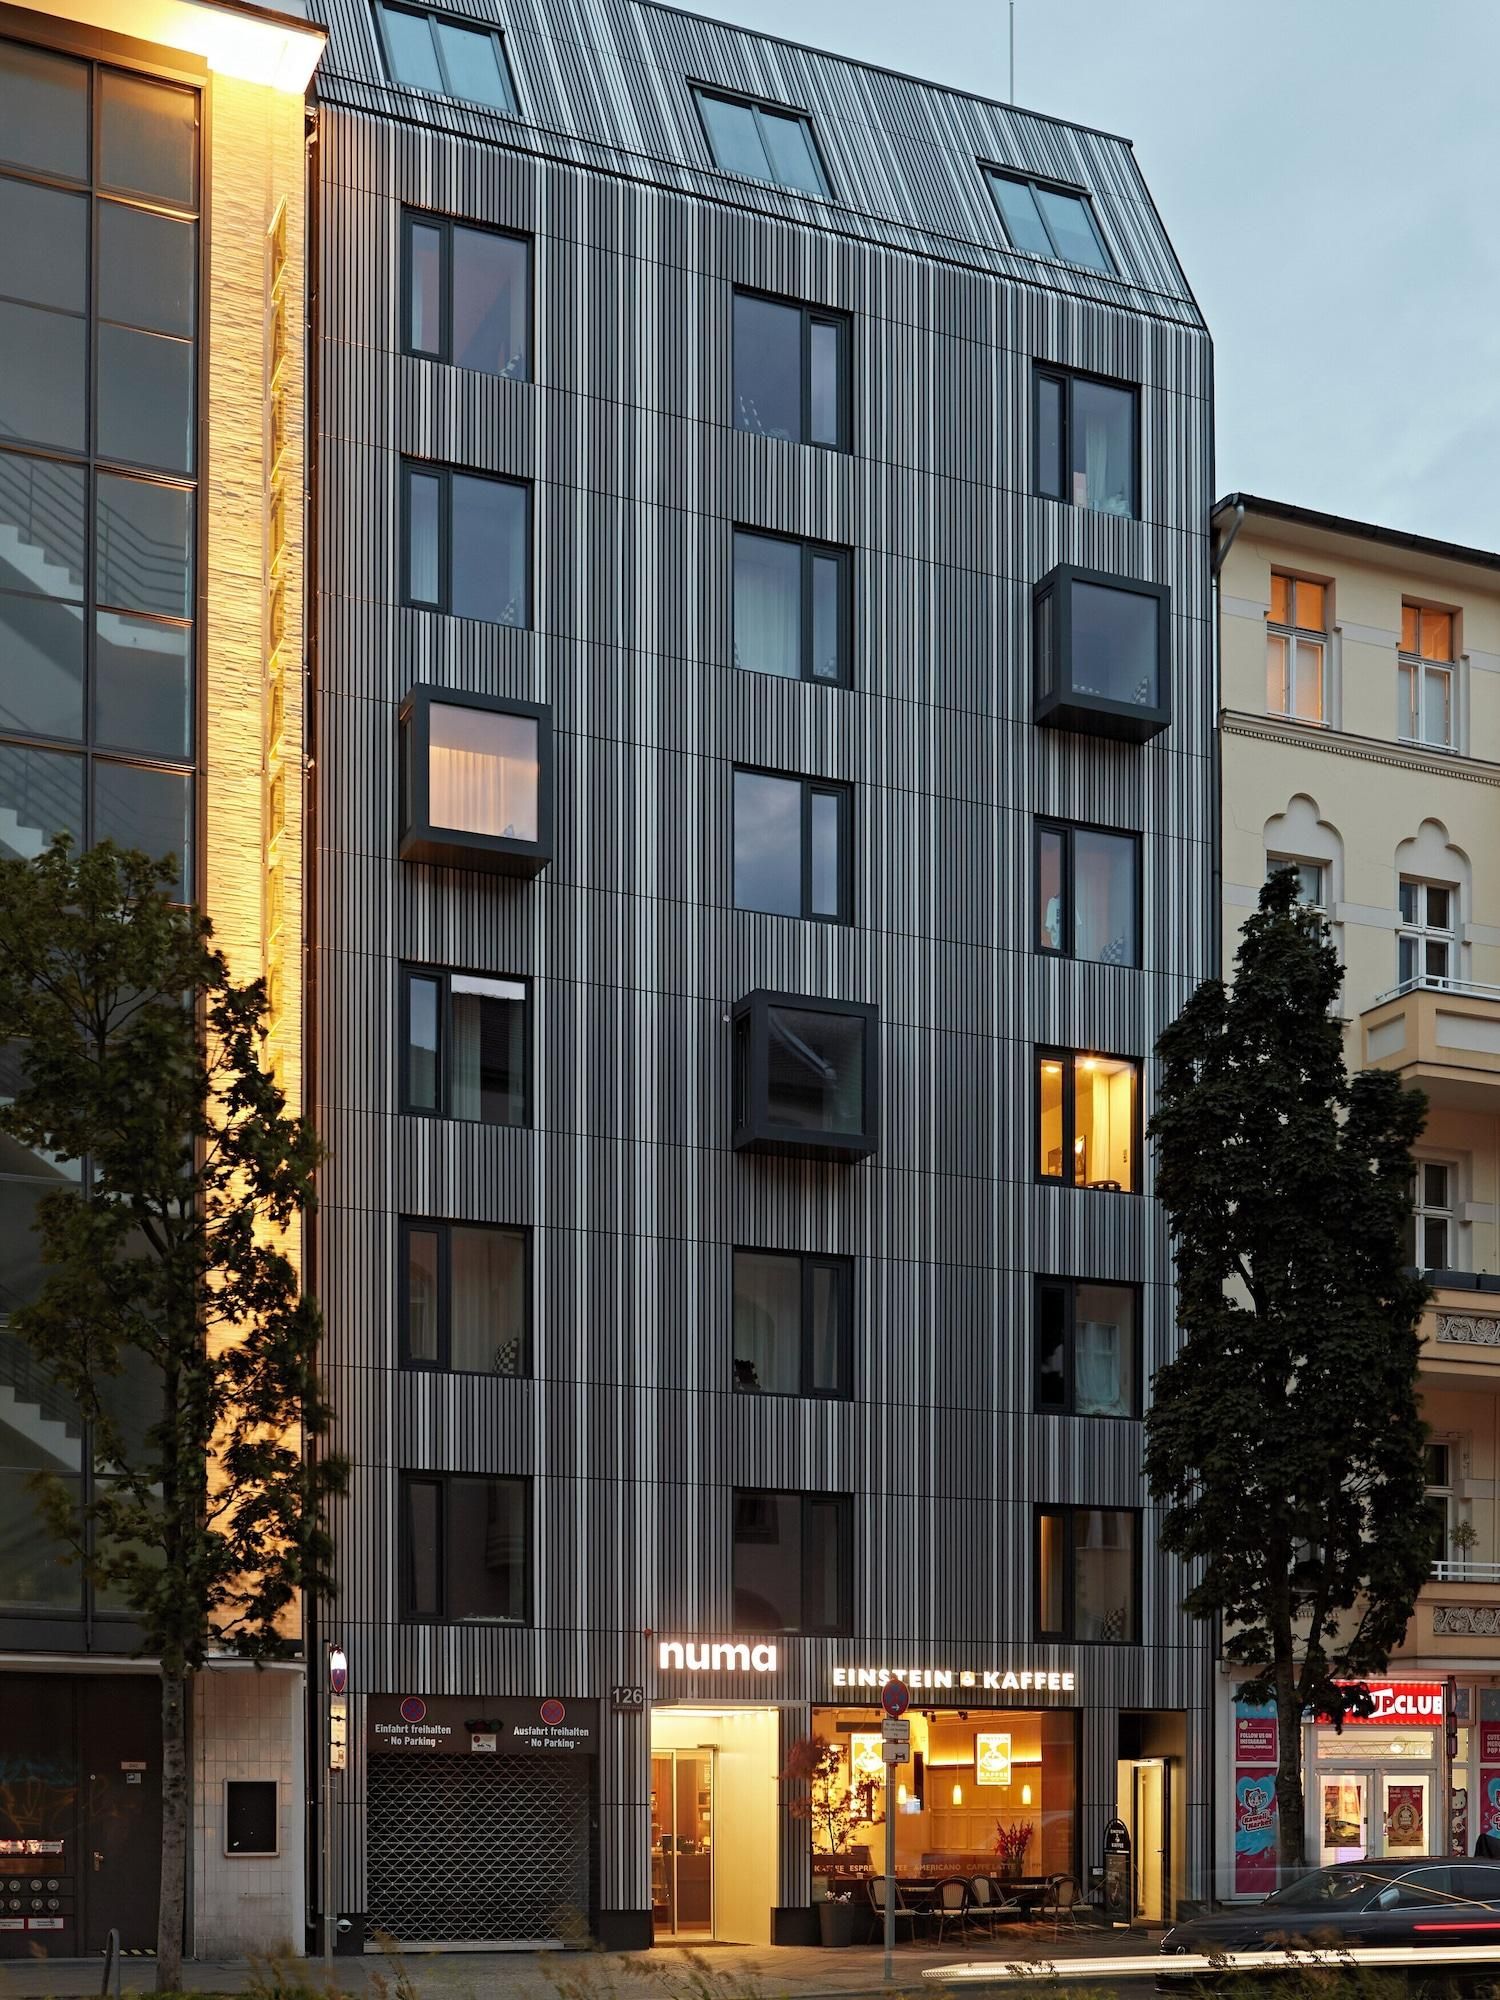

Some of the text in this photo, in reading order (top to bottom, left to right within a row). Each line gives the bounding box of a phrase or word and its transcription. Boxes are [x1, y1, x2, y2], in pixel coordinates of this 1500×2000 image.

[659, 1642, 777, 1672] numa
[833, 1668, 1075, 1691] EINSTEIN KAFFEE
[612, 1688, 643, 1704] 126
[375, 1724, 452, 1734] Einfahrt freihalten
[513, 1726, 589, 1736] Ausfahrt freihalten
[390, 1736, 402, 1745] No
[404, 1736, 436, 1747] Parking
[531, 1738, 542, 1747] No
[544, 1738, 574, 1749] Parking
[914, 1864, 961, 1872] AMERICANO
